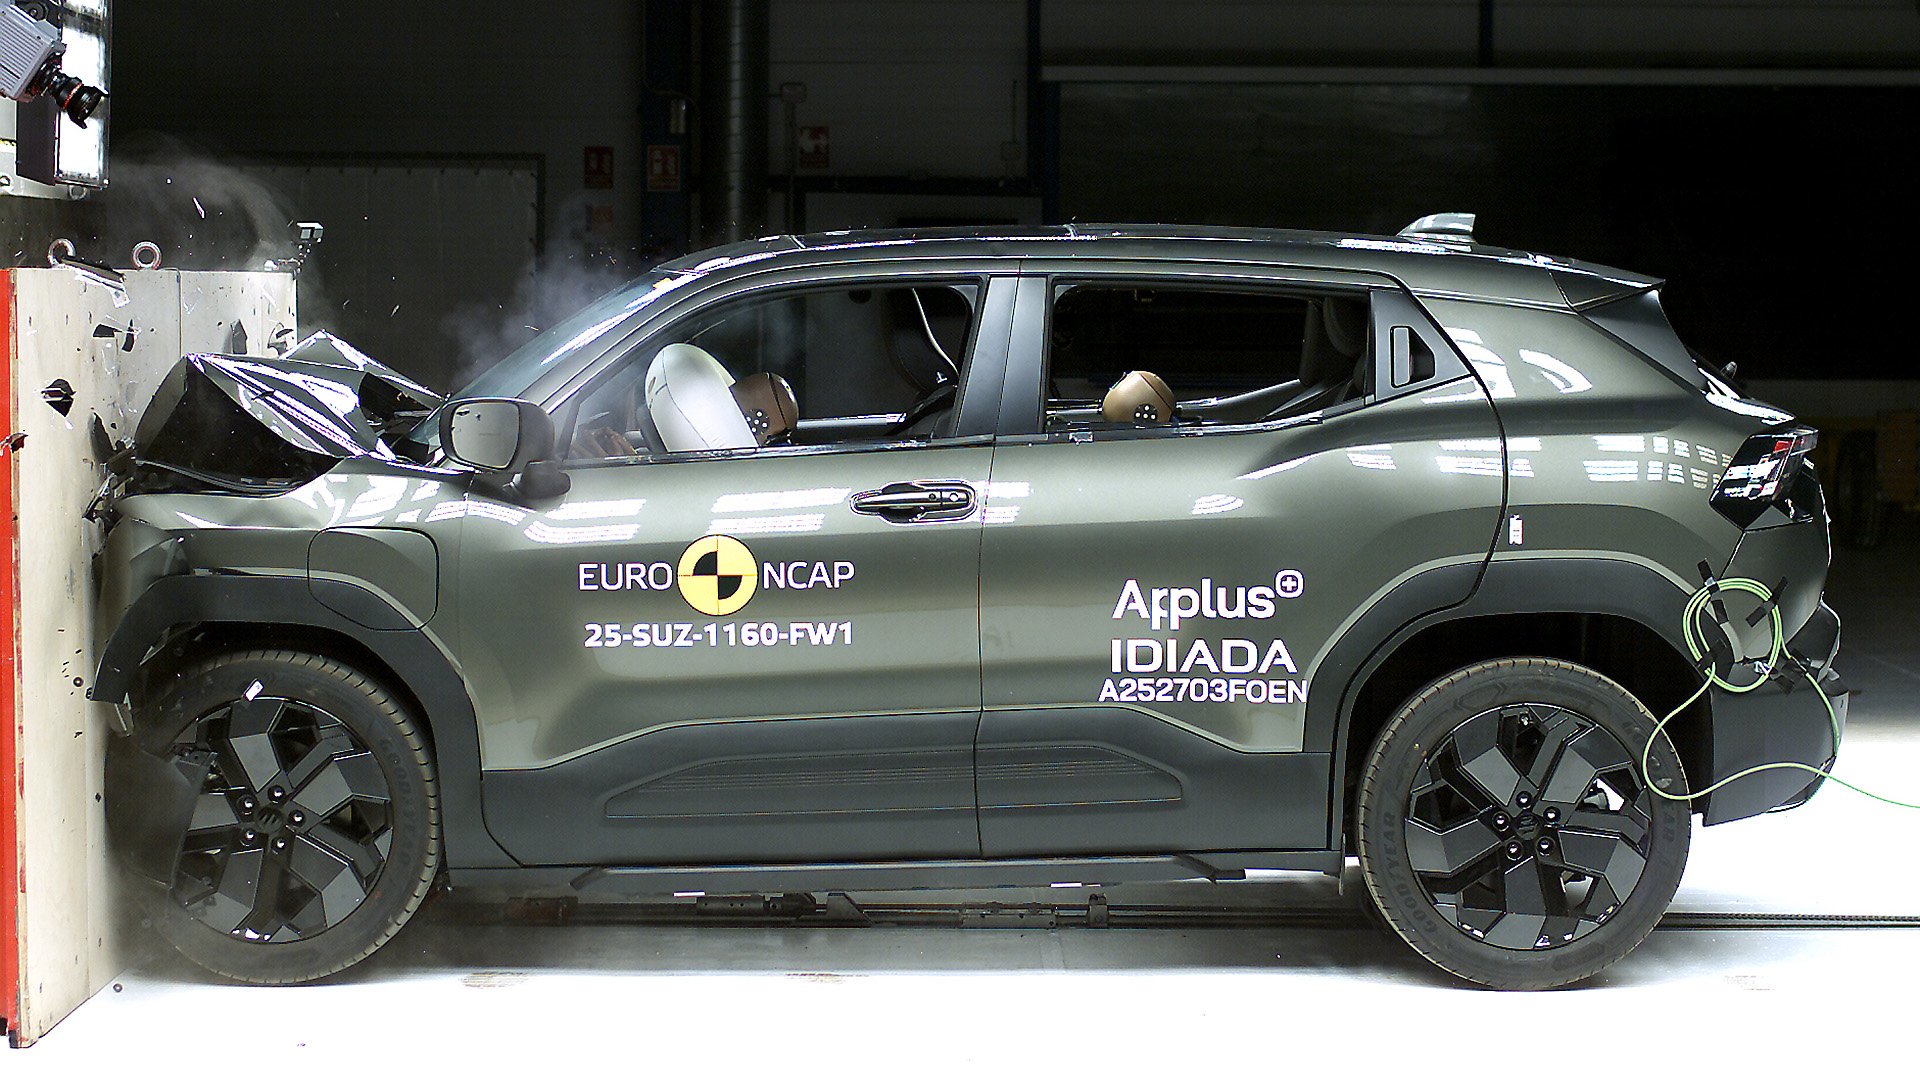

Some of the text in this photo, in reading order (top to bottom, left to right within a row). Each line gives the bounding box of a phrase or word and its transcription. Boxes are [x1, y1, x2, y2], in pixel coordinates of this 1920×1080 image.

[578, 561, 855, 591] EURO NCAP
[584, 622, 852, 647] 25-SUZ-1160-FW1
[1111, 638, 1298, 674] IDIADA
[1383, 811, 1437, 933] GOODYEAR
